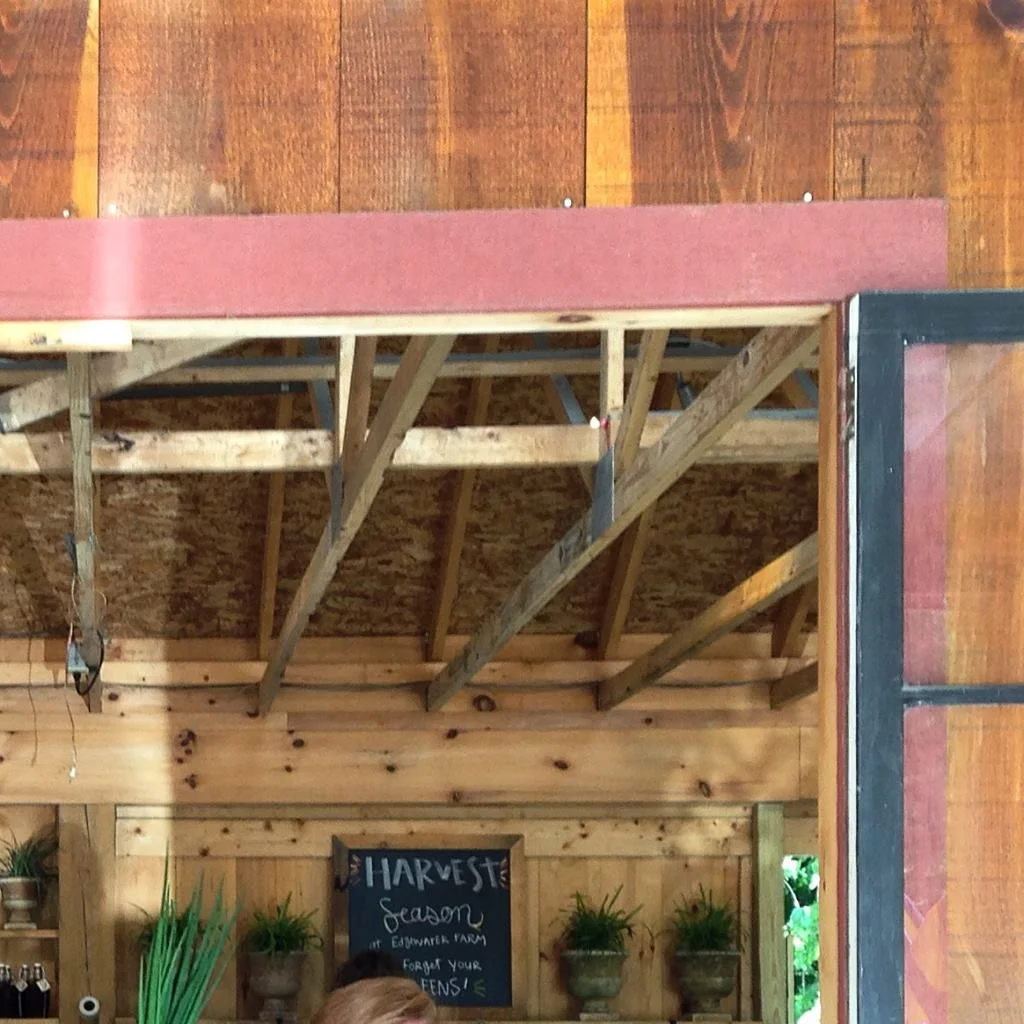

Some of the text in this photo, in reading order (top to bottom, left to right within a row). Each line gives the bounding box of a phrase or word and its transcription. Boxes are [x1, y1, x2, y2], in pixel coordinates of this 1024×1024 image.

[365, 856, 500, 891] HARVEST
[379, 897, 484, 934] Season
[421, 977, 469, 997] EENS!
